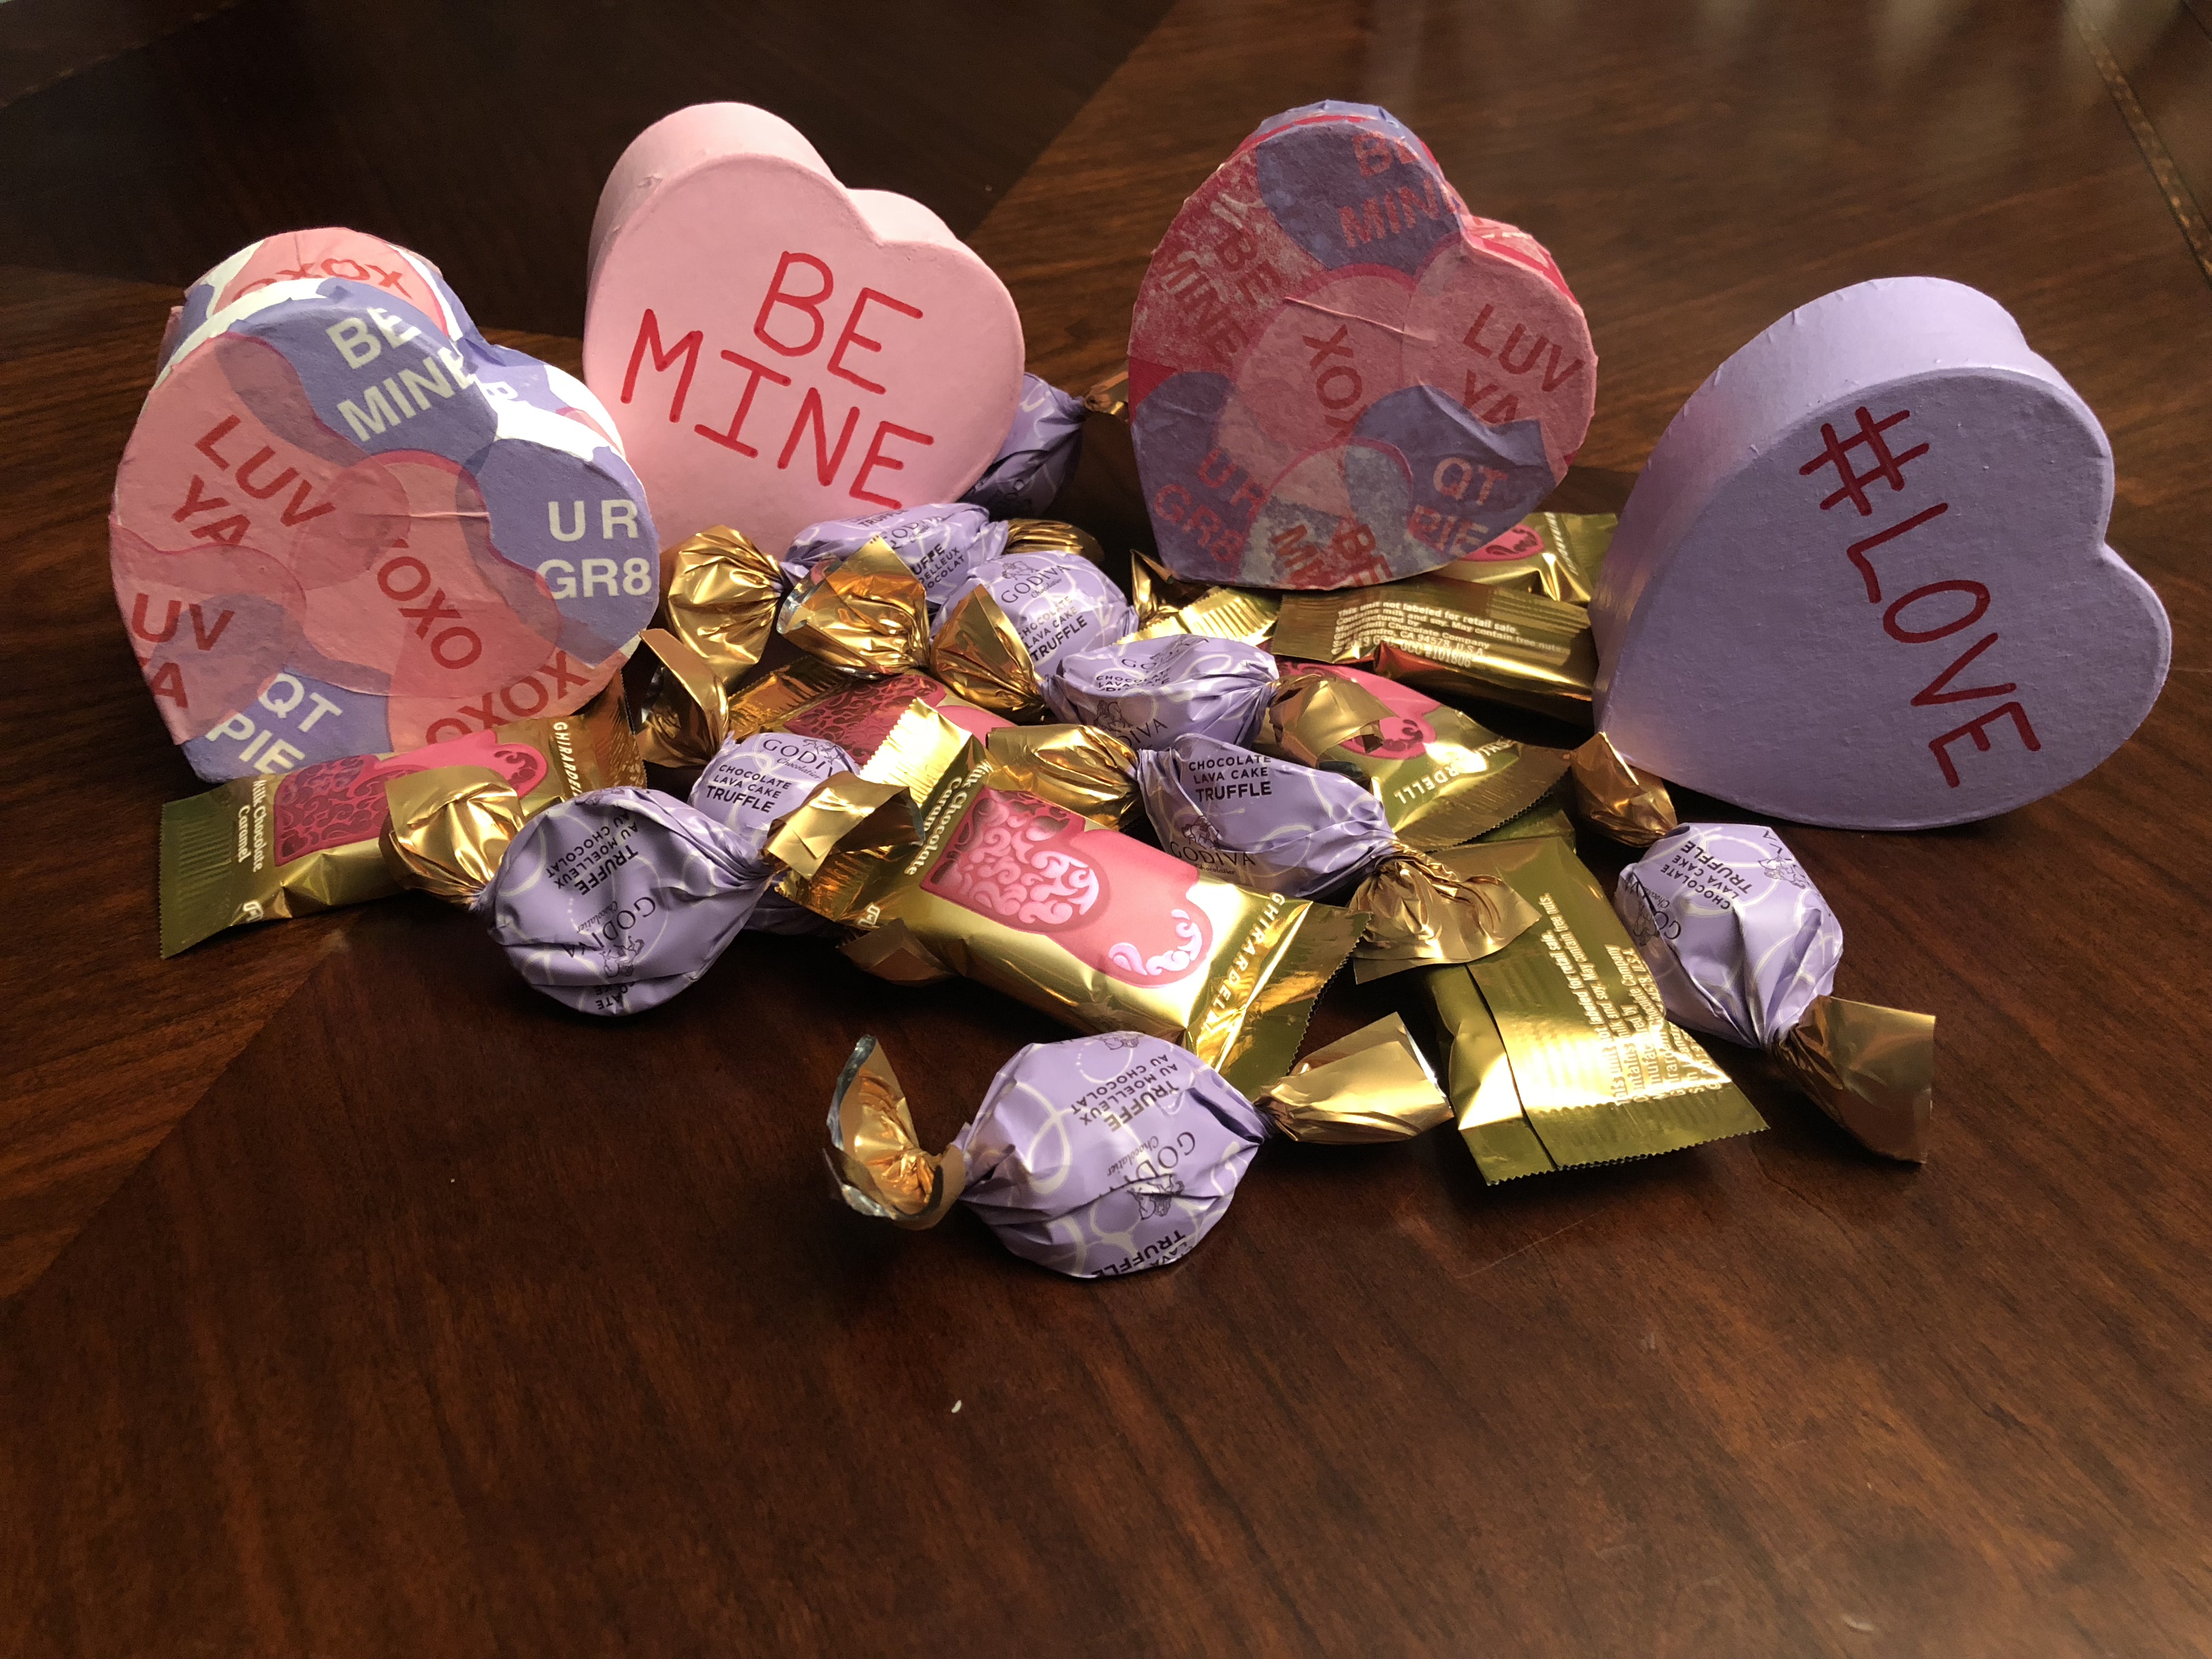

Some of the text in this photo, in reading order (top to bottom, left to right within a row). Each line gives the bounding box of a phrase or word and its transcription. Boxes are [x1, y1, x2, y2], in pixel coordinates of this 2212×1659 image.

[325, 307, 422, 370] BE
[754, 251, 923, 395] BE
[1463, 303, 1586, 392] LUV
[620, 308, 934, 510] MINE
[193, 414, 336, 533] LUV
[1433, 457, 1508, 506] QT
[171, 475, 251, 546] YA
[549, 499, 639, 542] U R
[1154, 484, 1246, 563] GR8
[1407, 504, 1489, 557] PIE
[536, 557, 652, 600] GR8
[1001, 565, 1072, 604] GODIVA
[1799, 407, 2041, 787] #LOVE
[377, 538, 483, 670] OXO
[1383, 601, 1400, 610] not
[1403, 603, 1442, 618] labeled
[1444, 611, 1460, 621] for
[1463, 615, 1491, 629] retail
[1383, 609, 1405, 617] milk
[1407, 613, 1427, 622] and
[1452, 621, 1474, 633] May
[1474, 627, 1513, 641] contain
[1026, 606, 1080, 650] LAVA CAKE
[1029, 615, 1088, 662] TRUFFLE
[1388, 620, 1440, 636] Chocolate
[1441, 631, 1489, 650] Company
[1400, 630, 1414, 640] CA
[138, 656, 189, 709] A
[258, 673, 343, 733] QT
[205, 709, 306, 775] PIE
[1188, 755, 1271, 772] CHOCOLATE
[713, 775, 782, 799] LAVA CAKE
[719, 764, 792, 791] CHOCOLATE
[777, 758, 821, 780] Chocolatier
[1193, 767, 1268, 785] LAVA CAKE
[706, 785, 775, 814] TRUFFLE
[1195, 781, 1272, 803] TRUFFLE
[238, 805, 251, 863] Caramel
[253, 806, 267, 872] Chocolate
[904, 759, 994, 875] Milk Chocolate
[545, 824, 611, 879] CHOCOLAT
[554, 822, 639, 890] AU MOELLEUX
[574, 845, 639, 896] TRUFFE
[1170, 841, 1256, 867] GODIVA
[1680, 840, 1753, 895] TRUFFLE
[1660, 863, 1731, 911] CHOCOLATE
[1672, 854, 1740, 900] LAVA CAKE
[577, 901, 618, 933] Chocolatier
[1538, 892, 1560, 915] nuts.
[1550, 914, 1570, 933] tree
[1541, 930, 1562, 951] sale.
[1550, 950, 1577, 974] retail
[1559, 931, 1588, 963] contain
[1566, 974, 1585, 990] for
[1578, 962, 1599, 981] May
[1604, 944, 1637, 987] Company
[1571, 989, 1605, 1025] labeled
[1596, 1001, 1620, 1020] and
[1620, 1005, 1640, 1017] by
[1629, 986, 1664, 1030] Chocolate
[1070, 1054, 1169, 1115] AU CHOCOLAT
[1079, 1063, 1178, 1126] AU MOELLEUX
[1103, 1080, 1180, 1133] TRUFFE
[1107, 1136, 1159, 1177] Chocolatier
